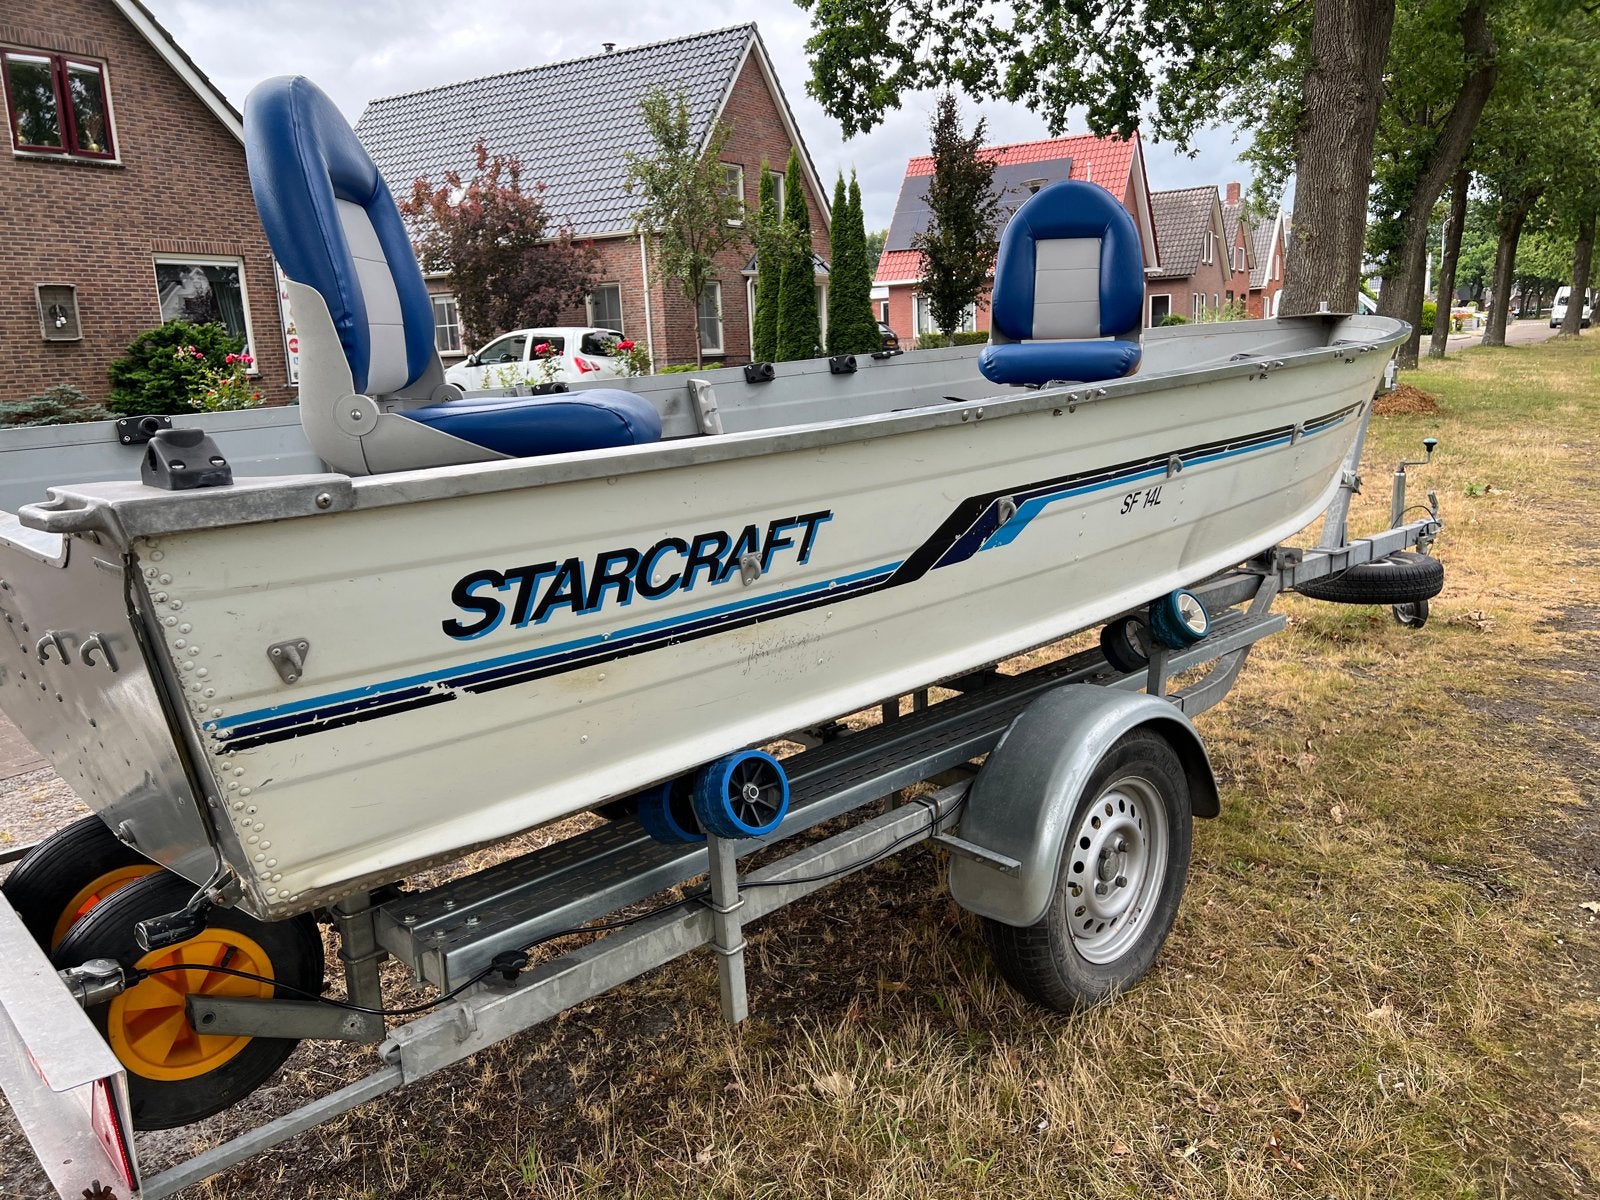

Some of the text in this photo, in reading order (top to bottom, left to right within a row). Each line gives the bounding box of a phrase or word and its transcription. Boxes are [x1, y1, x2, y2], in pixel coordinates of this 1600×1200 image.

[1120, 486, 1162, 515] SF 14L
[442, 509, 834, 641] STARCRAFT
